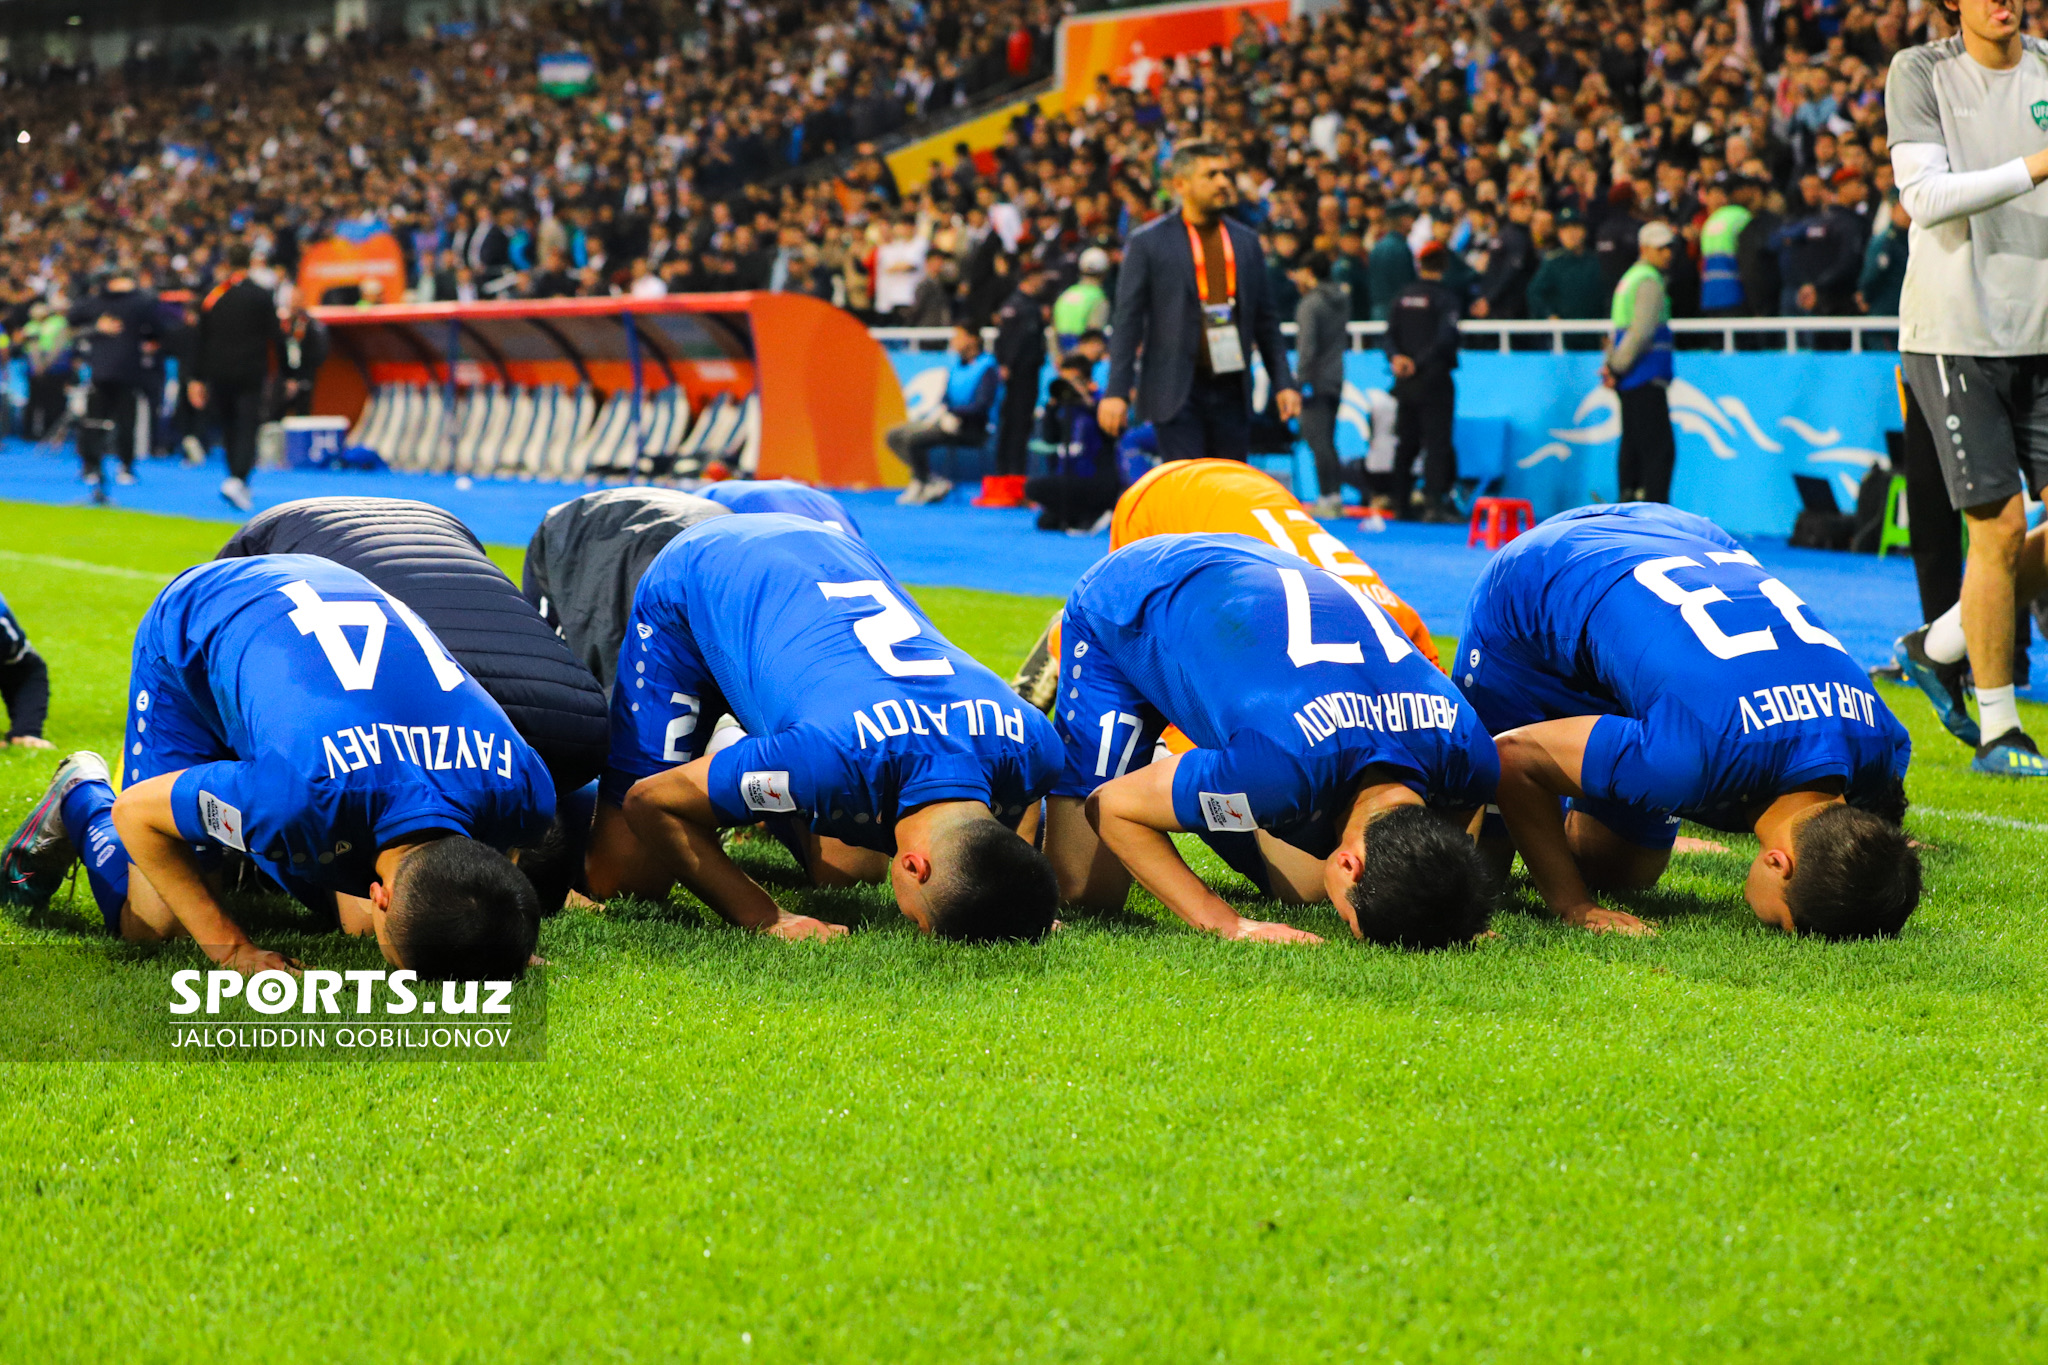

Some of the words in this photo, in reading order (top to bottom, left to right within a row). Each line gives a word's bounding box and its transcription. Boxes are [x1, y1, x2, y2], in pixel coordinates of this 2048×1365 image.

[278, 579, 465, 691] 14
[817, 580, 955, 677] 2
[1276, 567, 1413, 668] 17
[1633, 549, 1849, 660] 23
[663, 692, 700, 762] 2
[853, 699, 1025, 750] PULATOV
[1738, 682, 1876, 735] JURABOEV
[322, 722, 512, 779] FAYZULLAEV
[1094, 710, 1144, 779] 17
